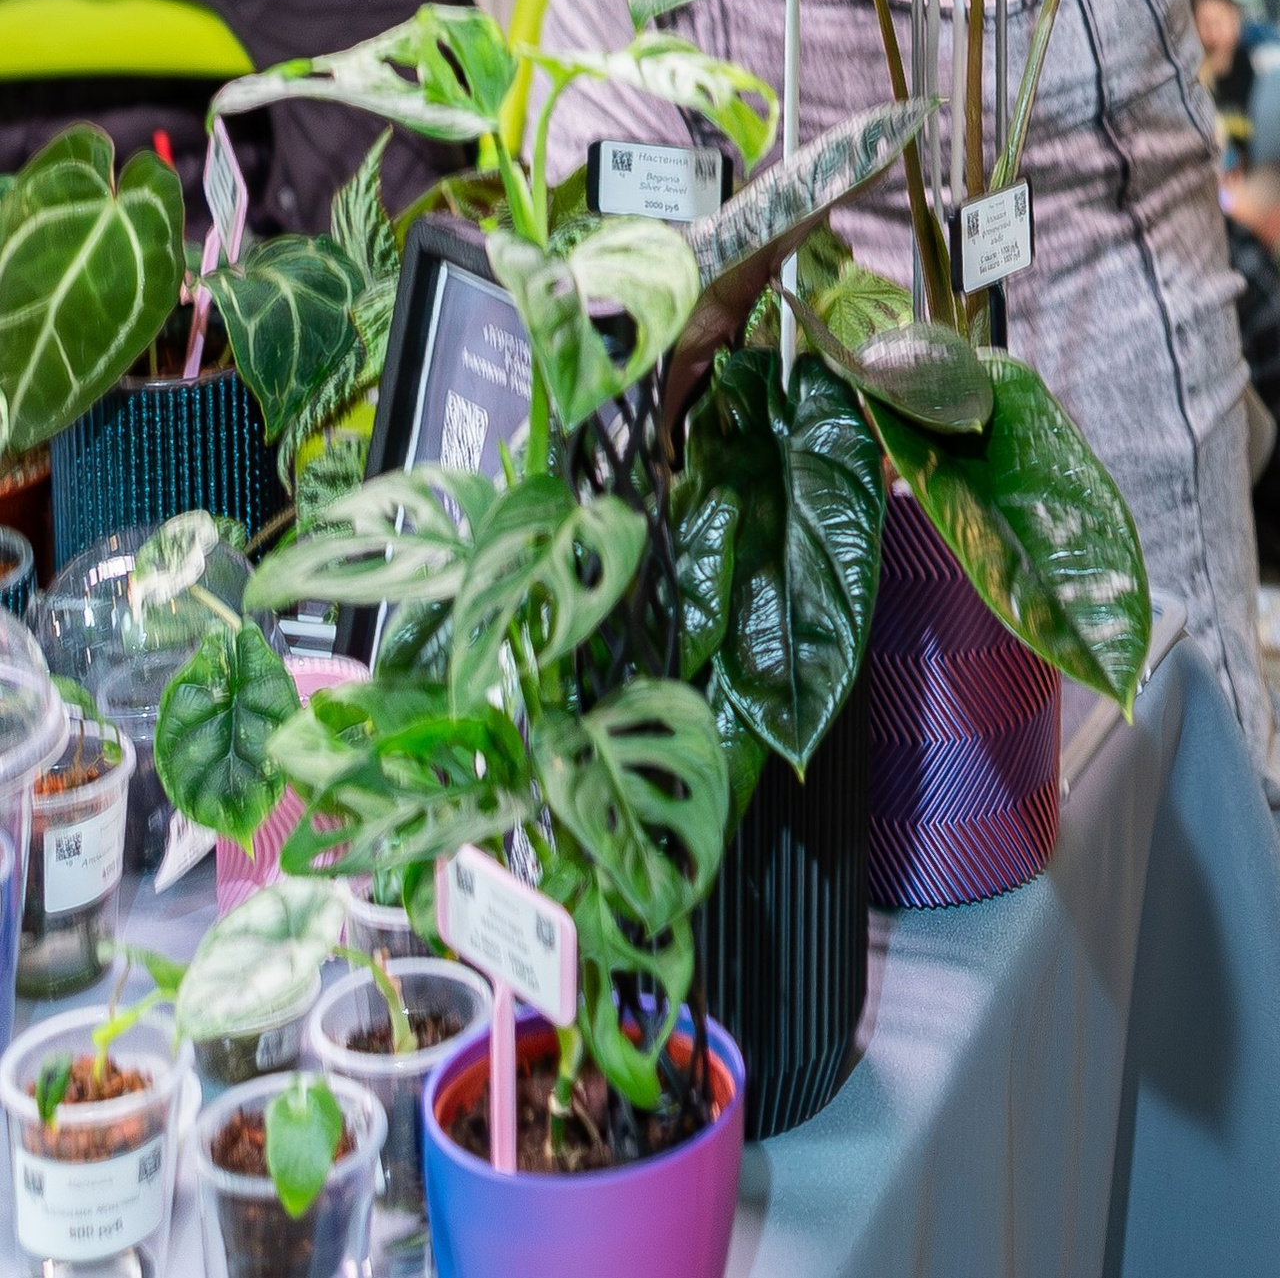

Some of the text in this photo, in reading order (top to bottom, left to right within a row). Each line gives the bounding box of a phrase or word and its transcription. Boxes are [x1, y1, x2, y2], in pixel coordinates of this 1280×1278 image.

[646, 172, 680, 184] Begonia
[644, 200, 680, 213] 2000 руб
